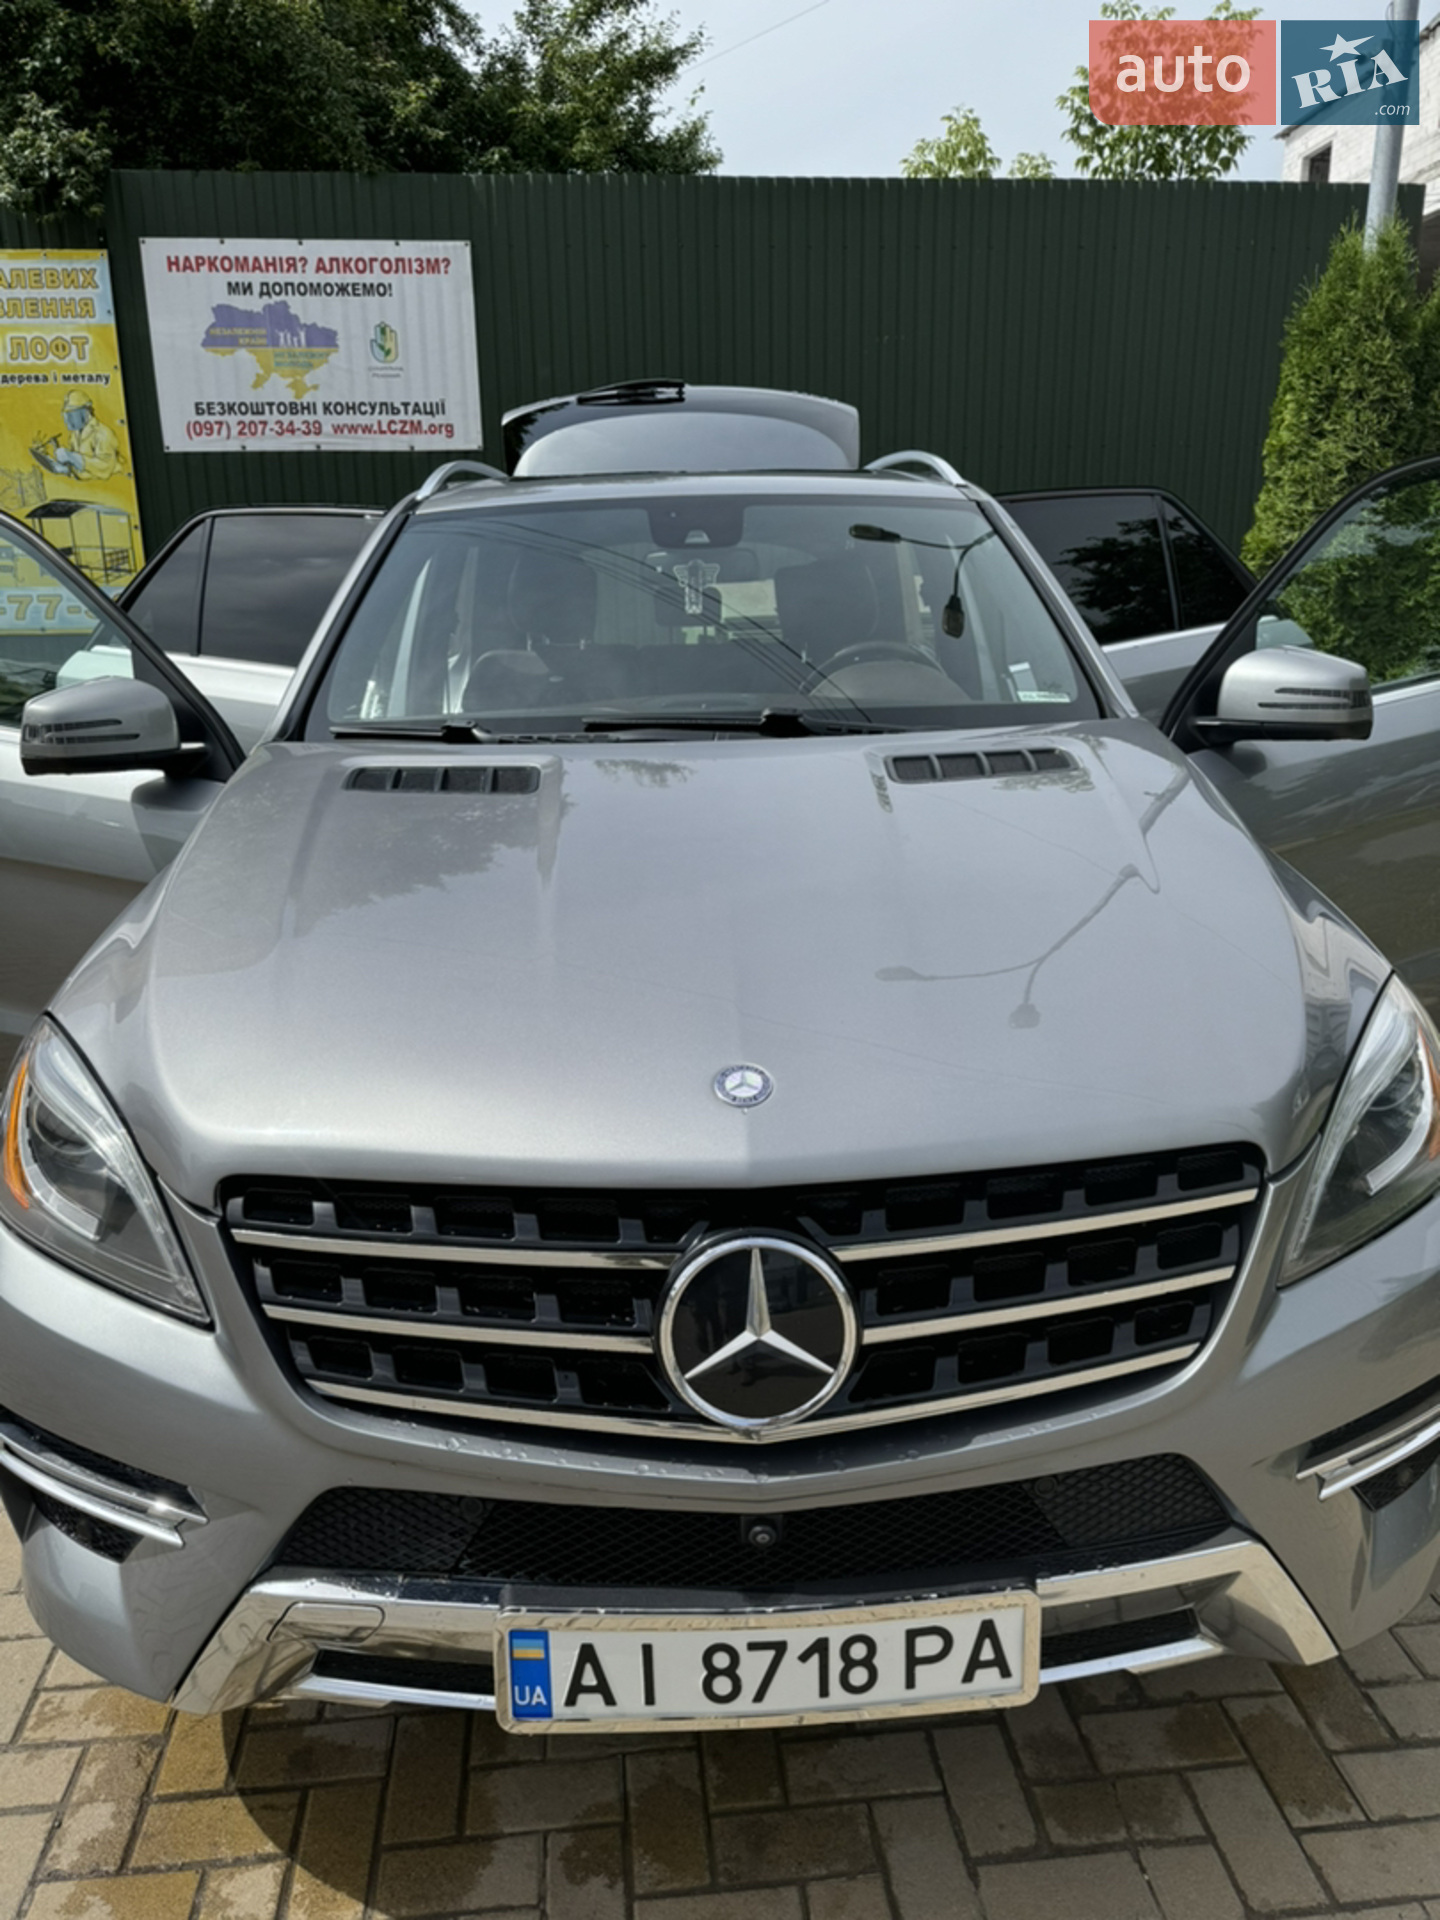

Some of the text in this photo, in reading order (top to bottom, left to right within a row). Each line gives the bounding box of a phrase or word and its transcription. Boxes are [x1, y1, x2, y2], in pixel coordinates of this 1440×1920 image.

[166, 255, 451, 275] НАРКОМАНІЯ? АЛКОГОЛІЗМ?
[227, 281, 393, 299] МИ ДОПОМОЖЕМО!
[10, 336, 90, 361] ЛОФТ
[1, 371, 111, 386] дерева і металу
[194, 398, 446, 417] БЕЗКОШТОВНІ КОНСУЛЬТАЦІЇ
[185, 420, 455, 440] (097) 207-34-39 www.LCZM.org
[563, 1618, 1013, 1707] AI 8718 PA
[514, 1684, 547, 1707] UA
